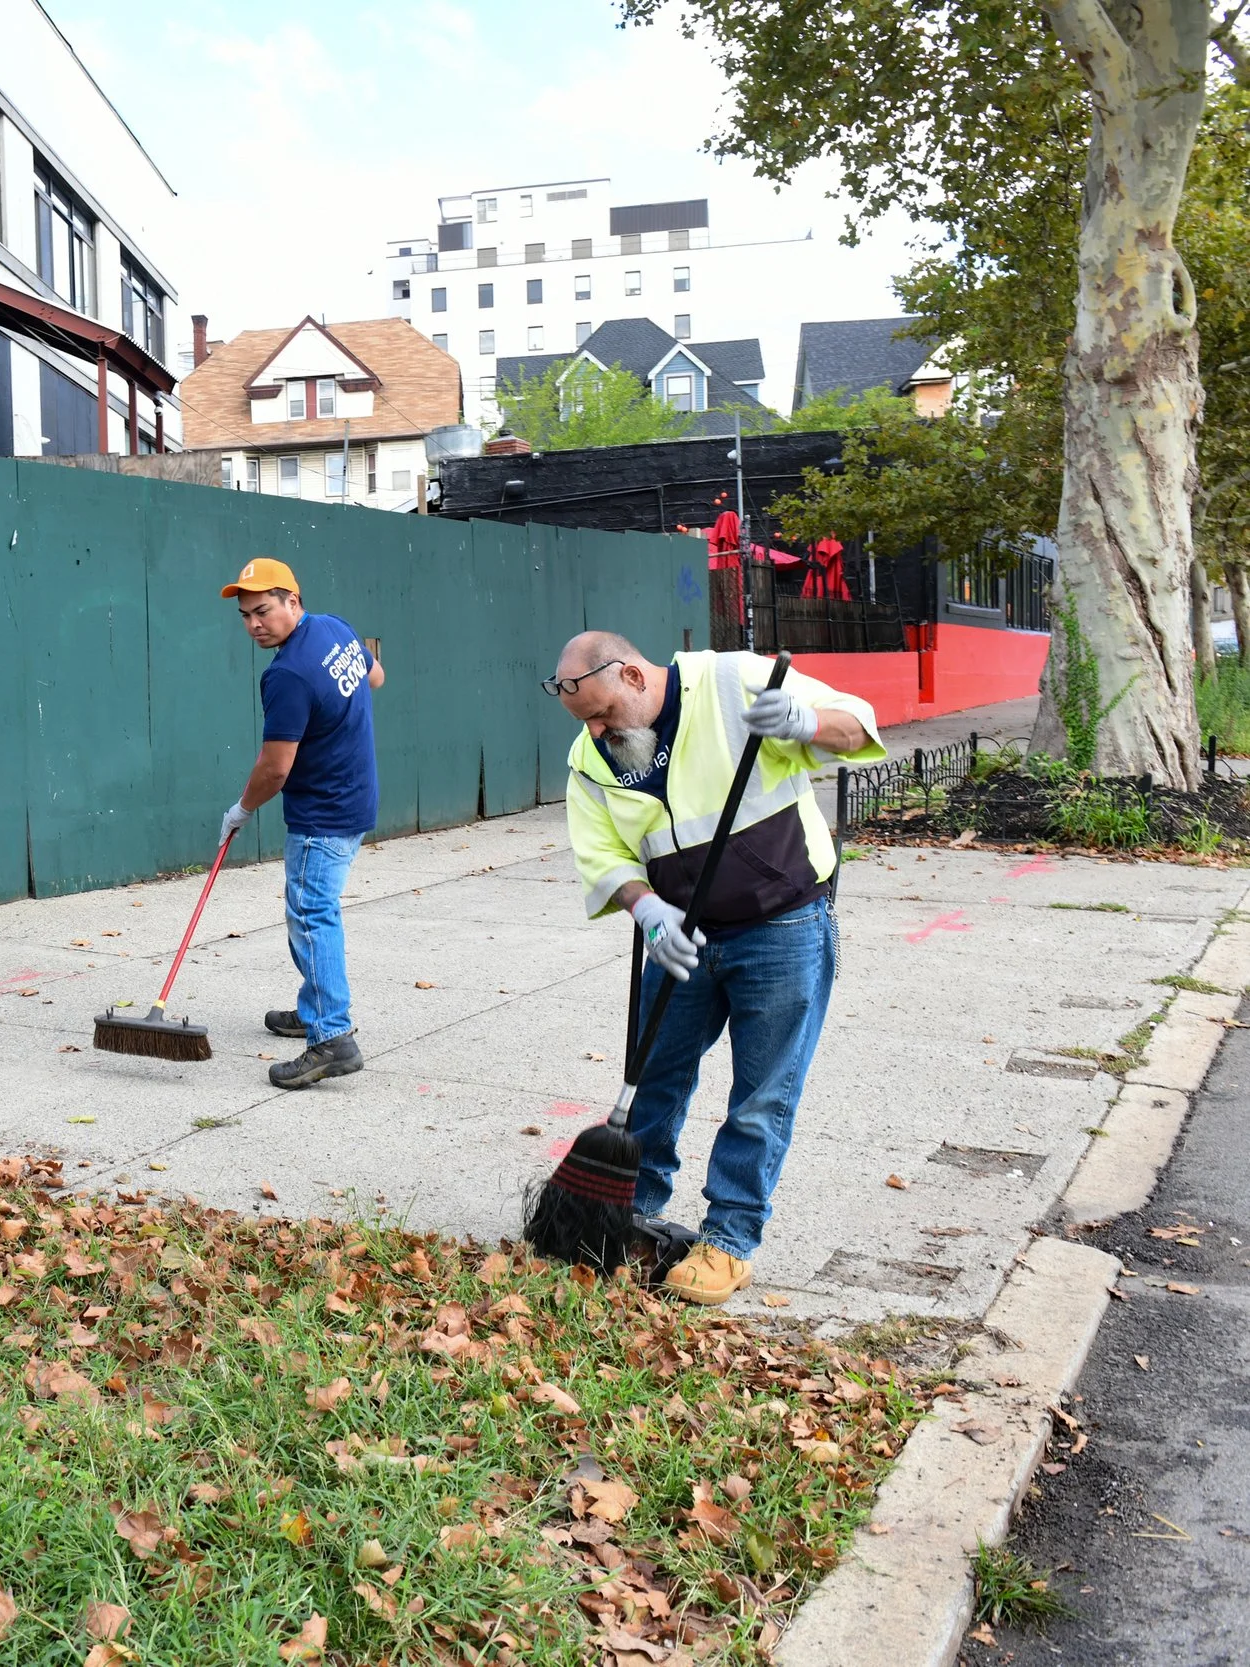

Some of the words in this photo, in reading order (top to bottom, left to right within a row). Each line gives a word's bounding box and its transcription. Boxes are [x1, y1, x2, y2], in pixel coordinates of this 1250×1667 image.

[329, 652, 351, 680] GRID
[344, 639, 362, 661] FOR
[338, 653, 368, 698] GOOD
